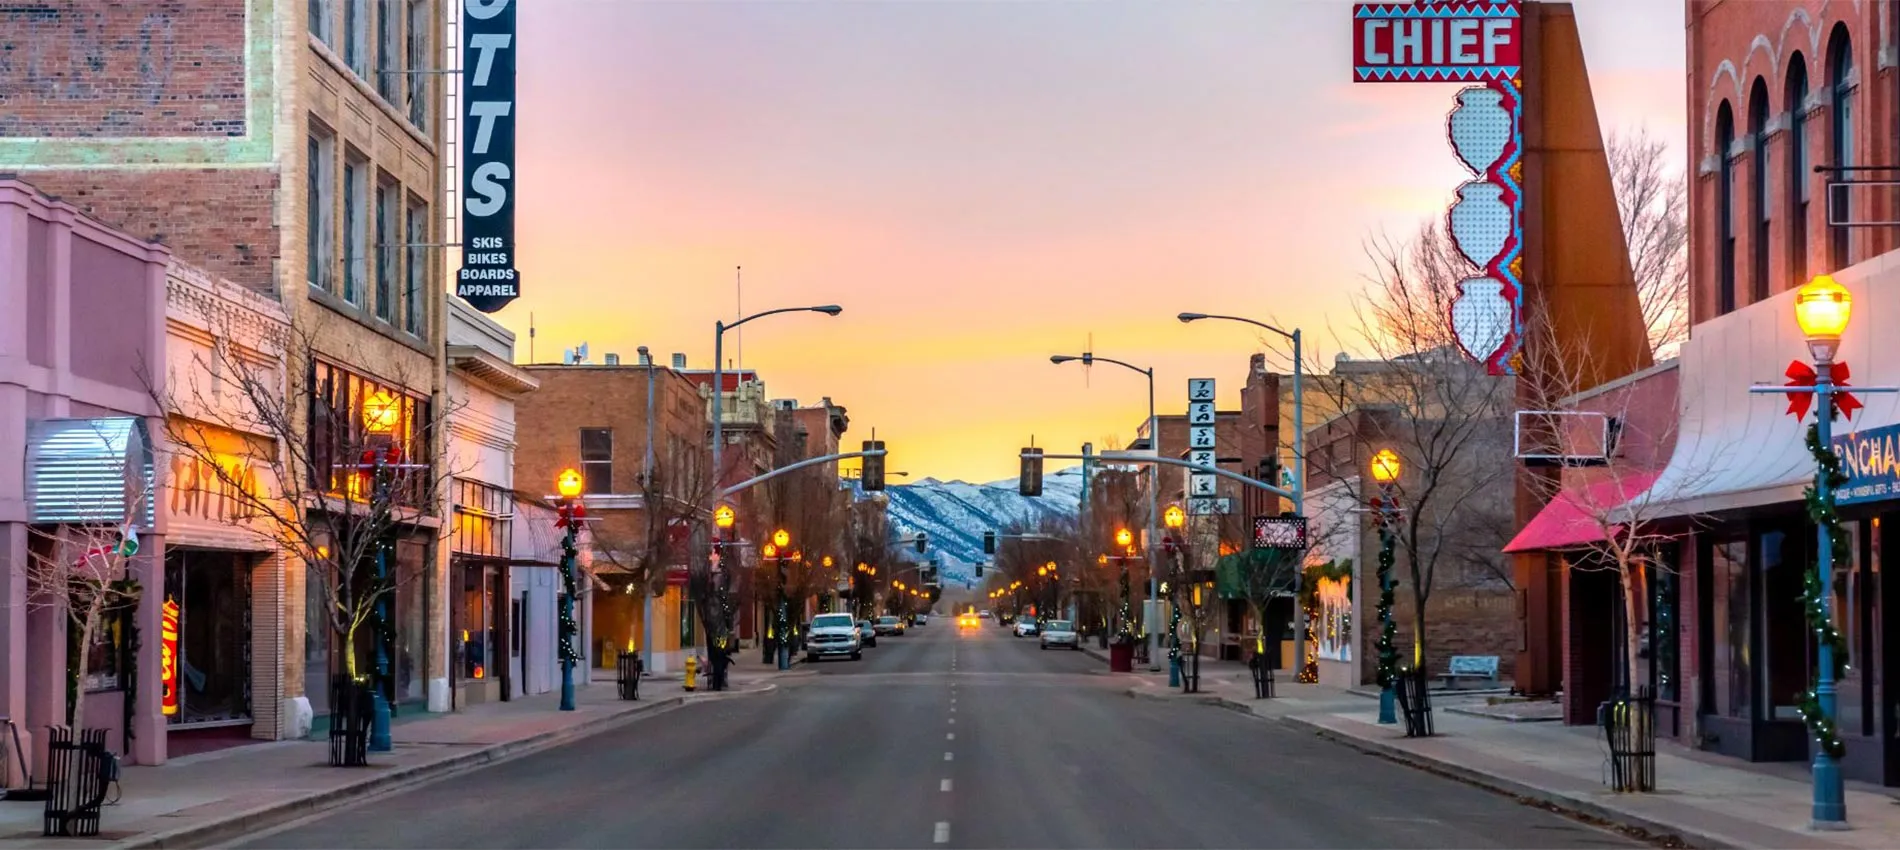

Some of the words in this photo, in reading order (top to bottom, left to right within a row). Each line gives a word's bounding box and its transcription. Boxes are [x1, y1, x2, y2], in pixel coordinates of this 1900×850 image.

[1364, 19, 1512, 64] CHIEF
[472, 237, 503, 248] SKIS
[468, 253, 507, 264] BIKES
[461, 269, 514, 280] BOARDS
[458, 285, 516, 296] APPAREL
